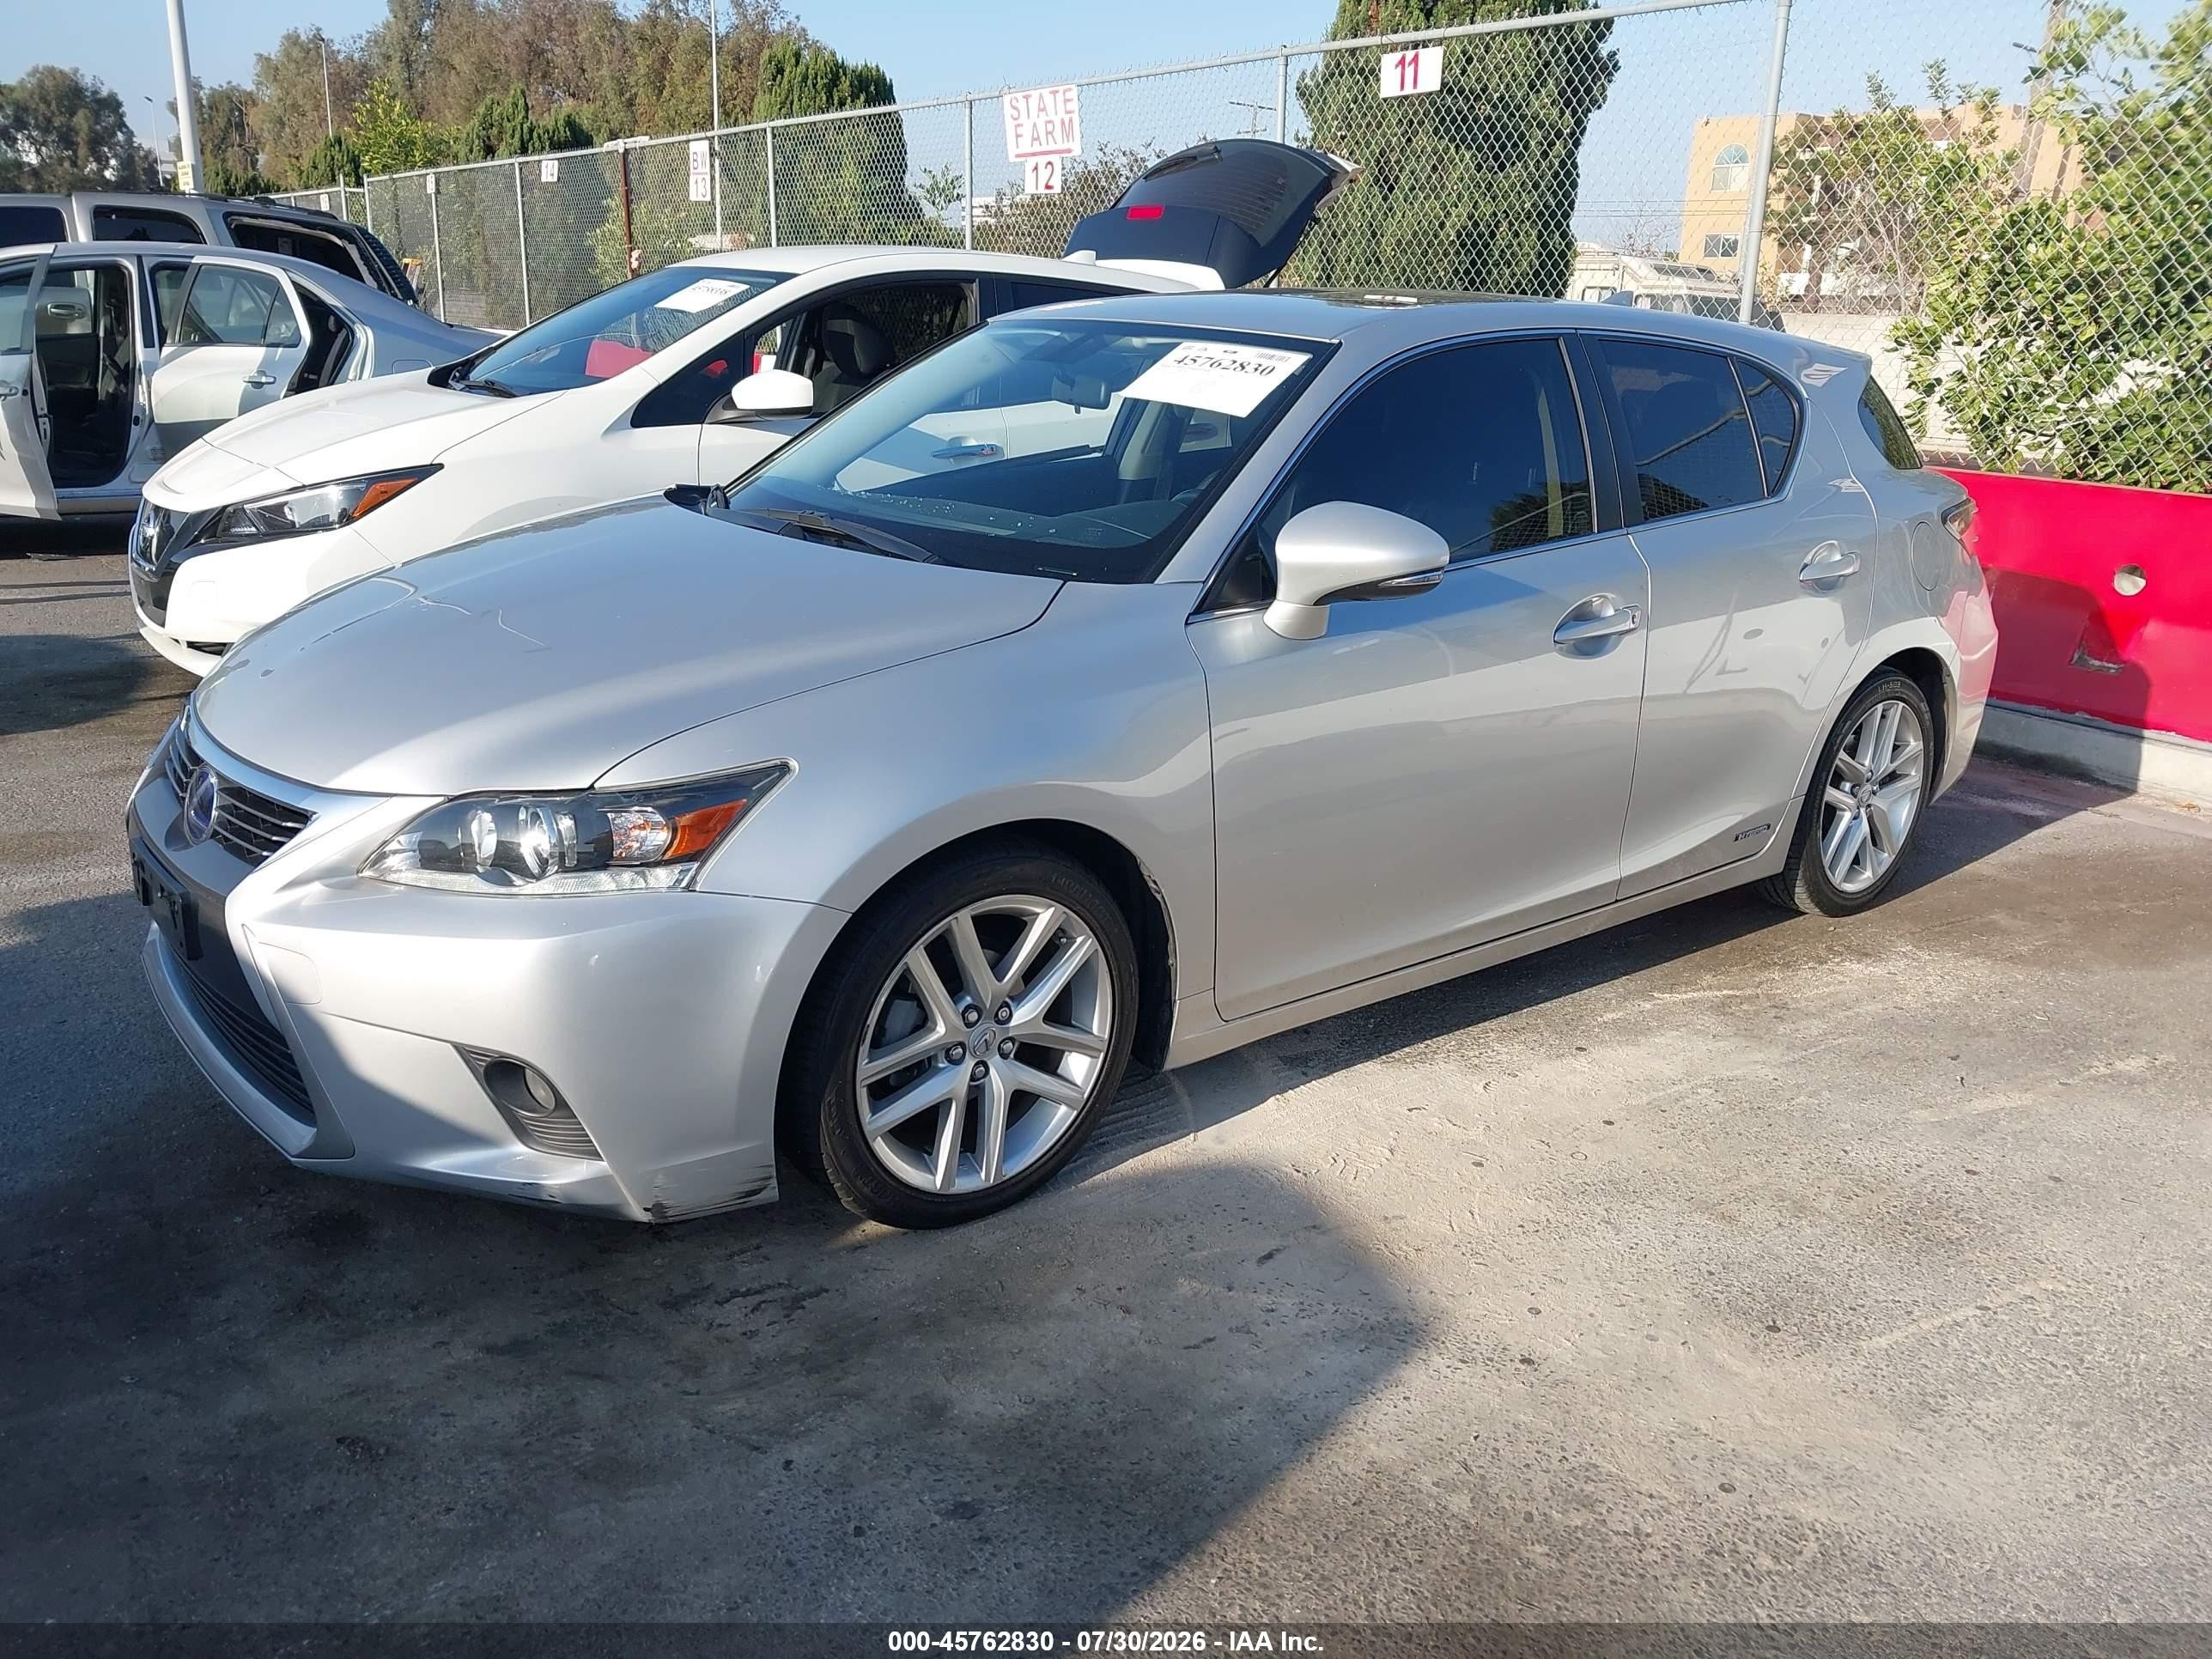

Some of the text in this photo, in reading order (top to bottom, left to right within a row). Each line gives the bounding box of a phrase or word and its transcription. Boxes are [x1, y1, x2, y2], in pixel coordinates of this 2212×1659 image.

[1395, 51, 1419, 93] 11
[1009, 87, 1075, 121] STATE
[1014, 117, 1075, 149] FARM
[544, 161, 555, 180] 14
[1031, 161, 1055, 191] 12
[694, 177, 708, 198] 13
[1174, 354, 1276, 376] 45762830
